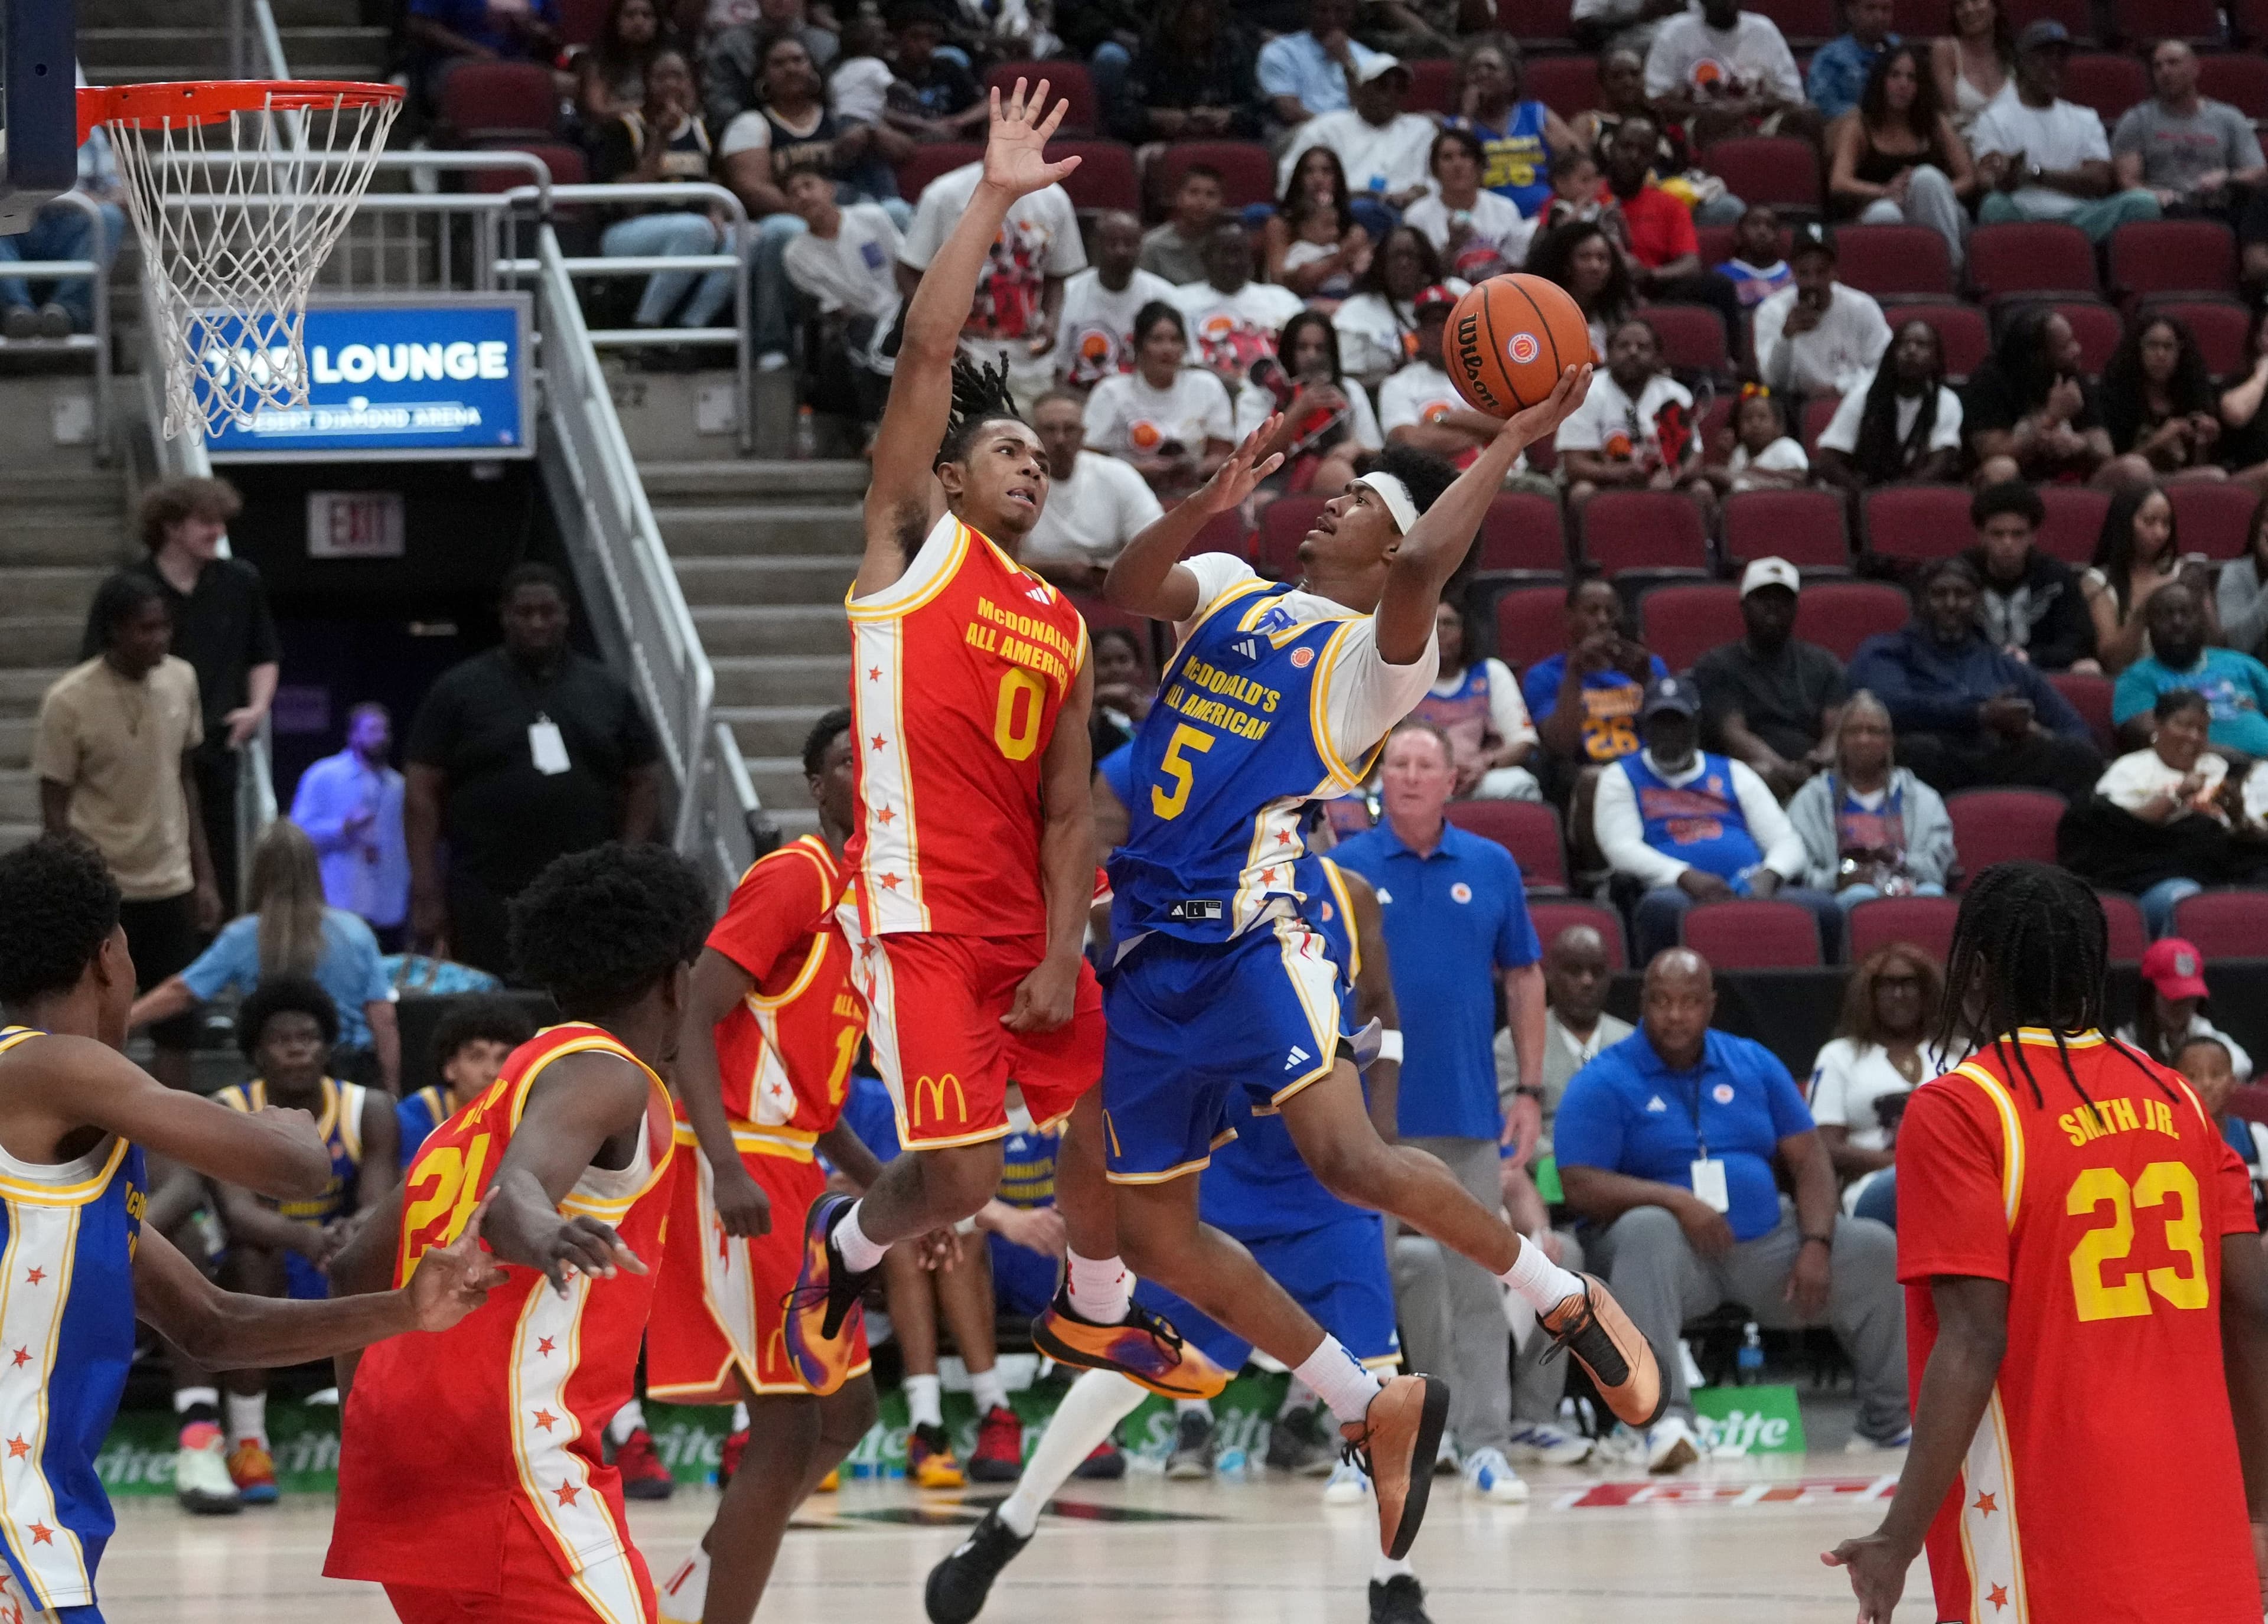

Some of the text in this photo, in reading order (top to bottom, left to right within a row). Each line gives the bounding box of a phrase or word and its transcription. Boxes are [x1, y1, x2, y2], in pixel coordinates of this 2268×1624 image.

[311, 341, 509, 383] LOUNGE
[1458, 311, 1499, 407] Wilson
[330, 502, 386, 546] EXIT
[966, 622, 996, 652] ALL
[977, 596, 1077, 670] McDONALD'S
[994, 666, 1047, 761] 0
[1164, 684, 1271, 741] ALL AMERICAN
[1151, 722, 1216, 821] 5
[2143, 1098, 2180, 1140] JR.
[2067, 1161, 2209, 1322] 23
